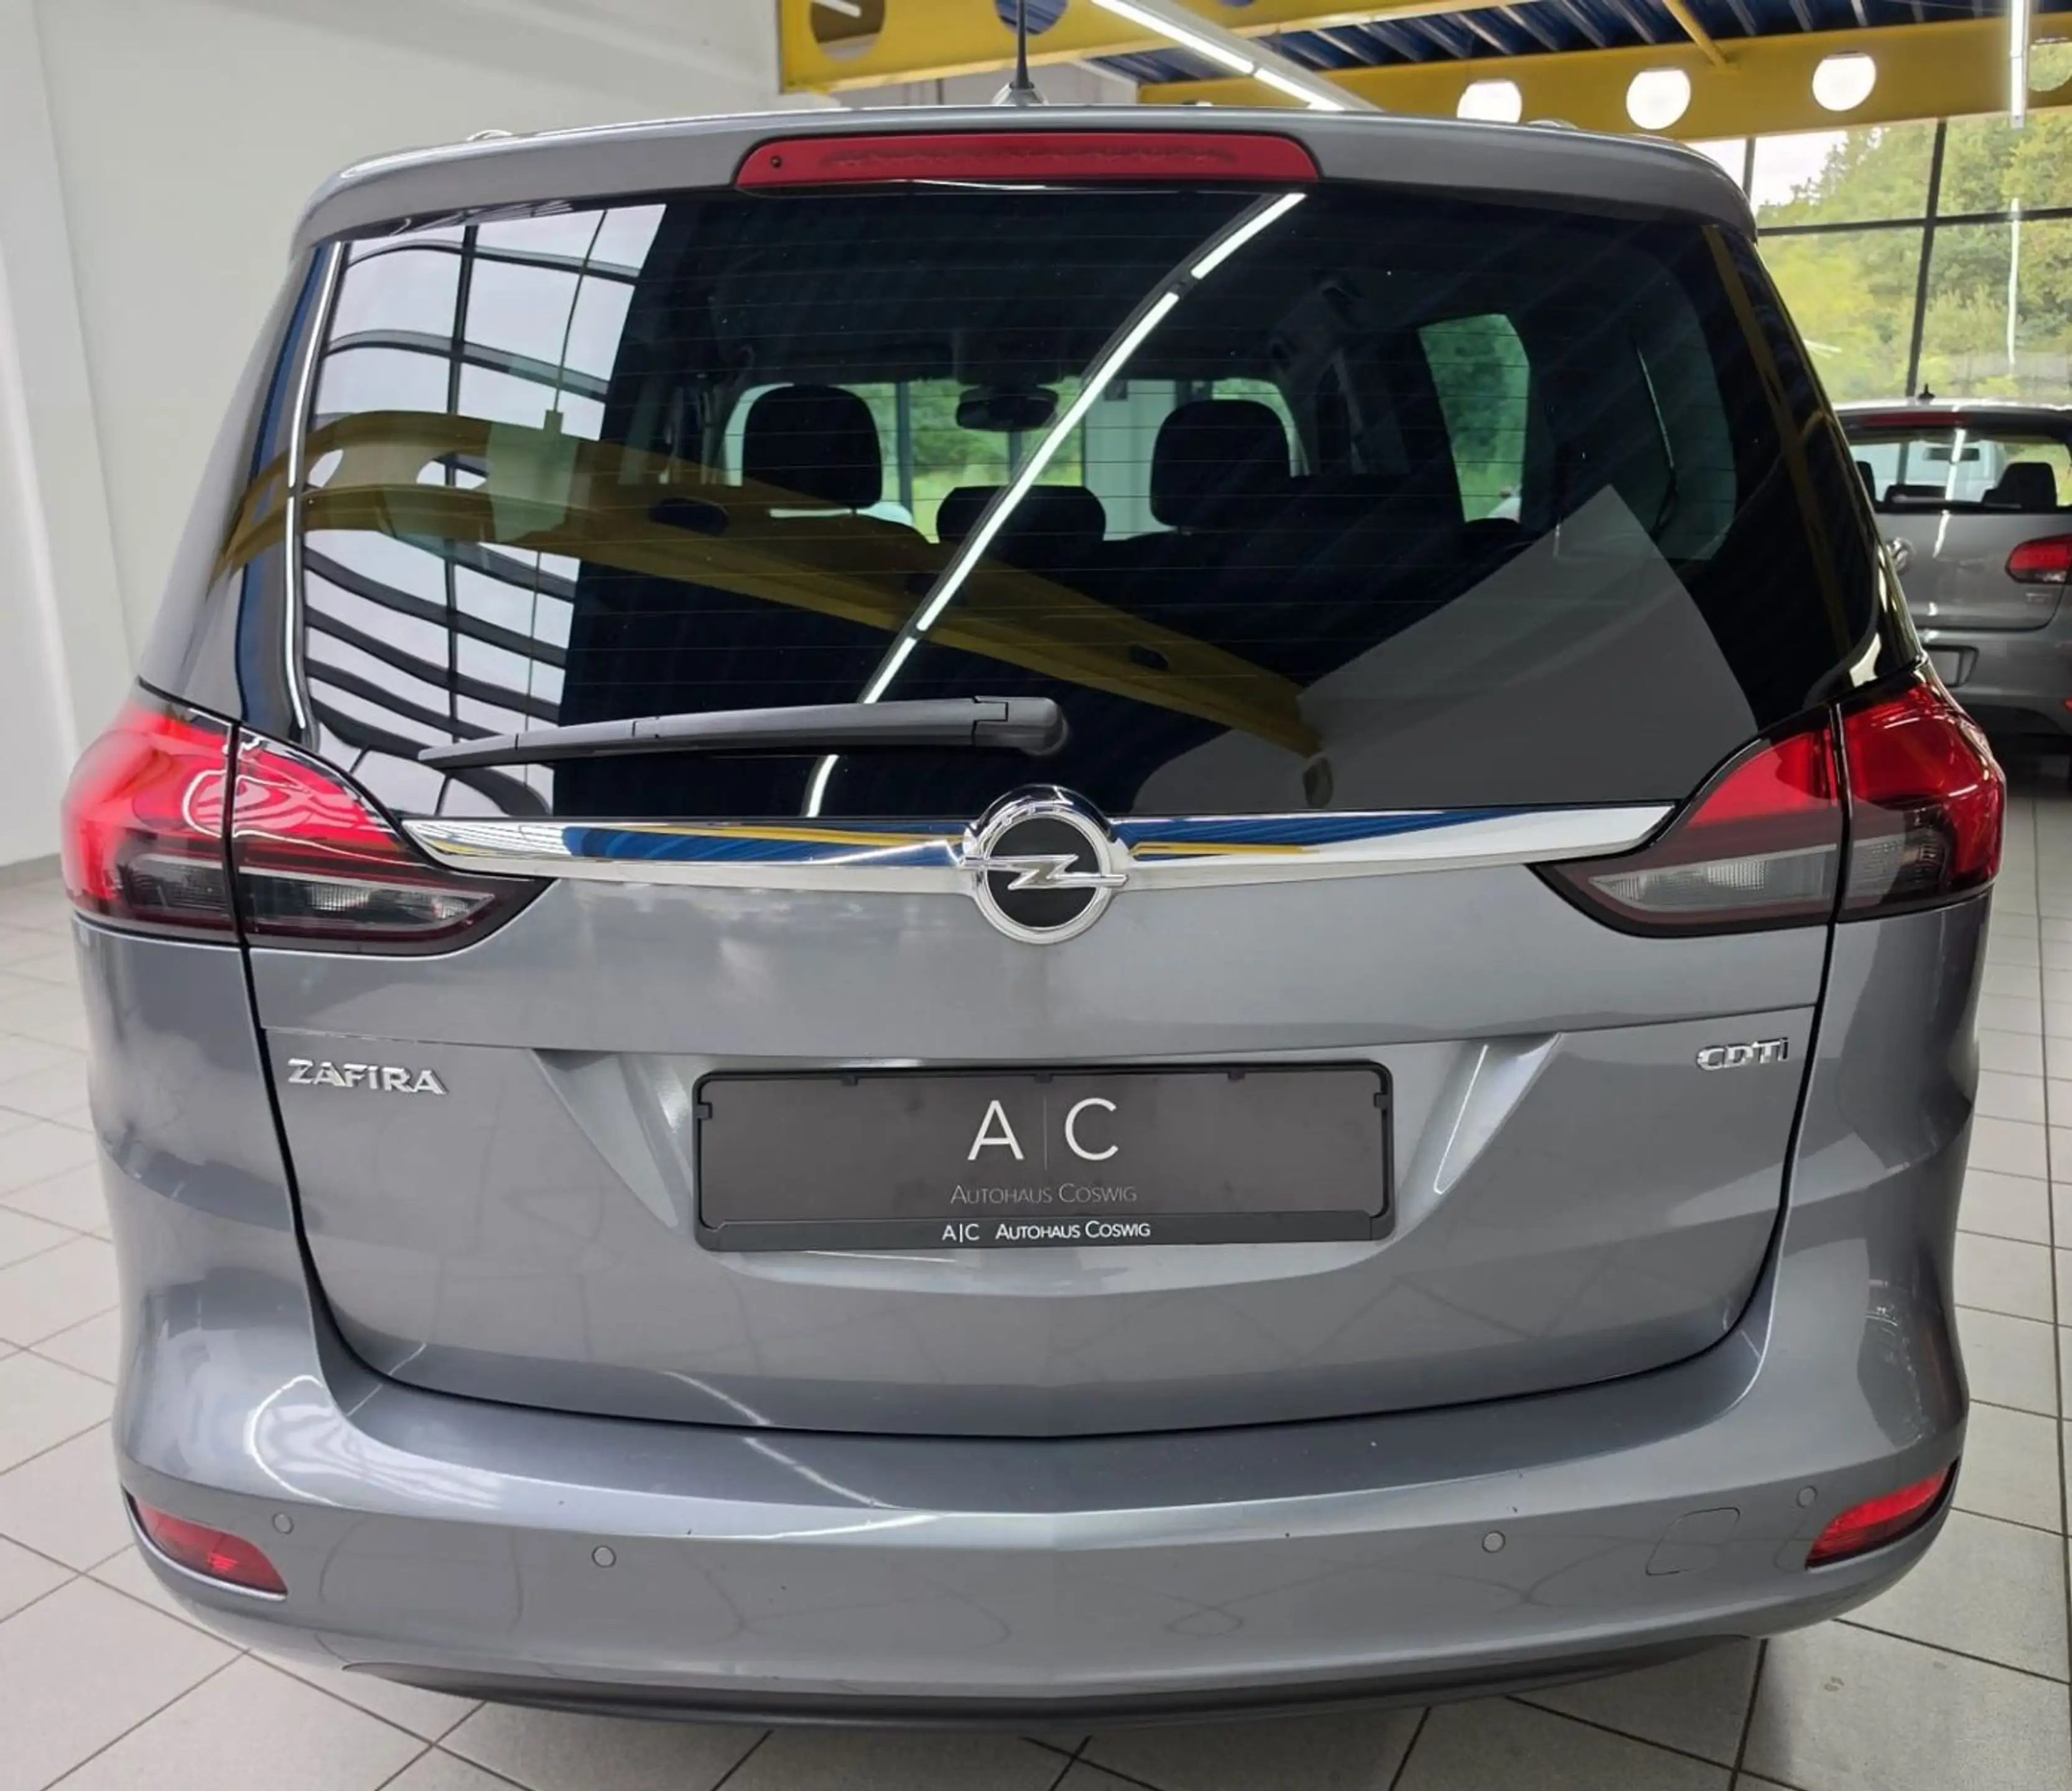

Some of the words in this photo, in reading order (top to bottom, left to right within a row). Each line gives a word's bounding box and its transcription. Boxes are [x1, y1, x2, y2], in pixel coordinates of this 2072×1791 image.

[287, 1058, 447, 1095] ZAFIRA
[967, 1100, 1024, 1160] A
[1065, 1098, 1118, 1160] C
[950, 1185, 1052, 1204] AUTOHAUS
[1059, 1183, 1138, 1203] COSWIG
[995, 1223, 1080, 1239] AUTOHAUS
[1085, 1220, 1150, 1238] COSWIG
